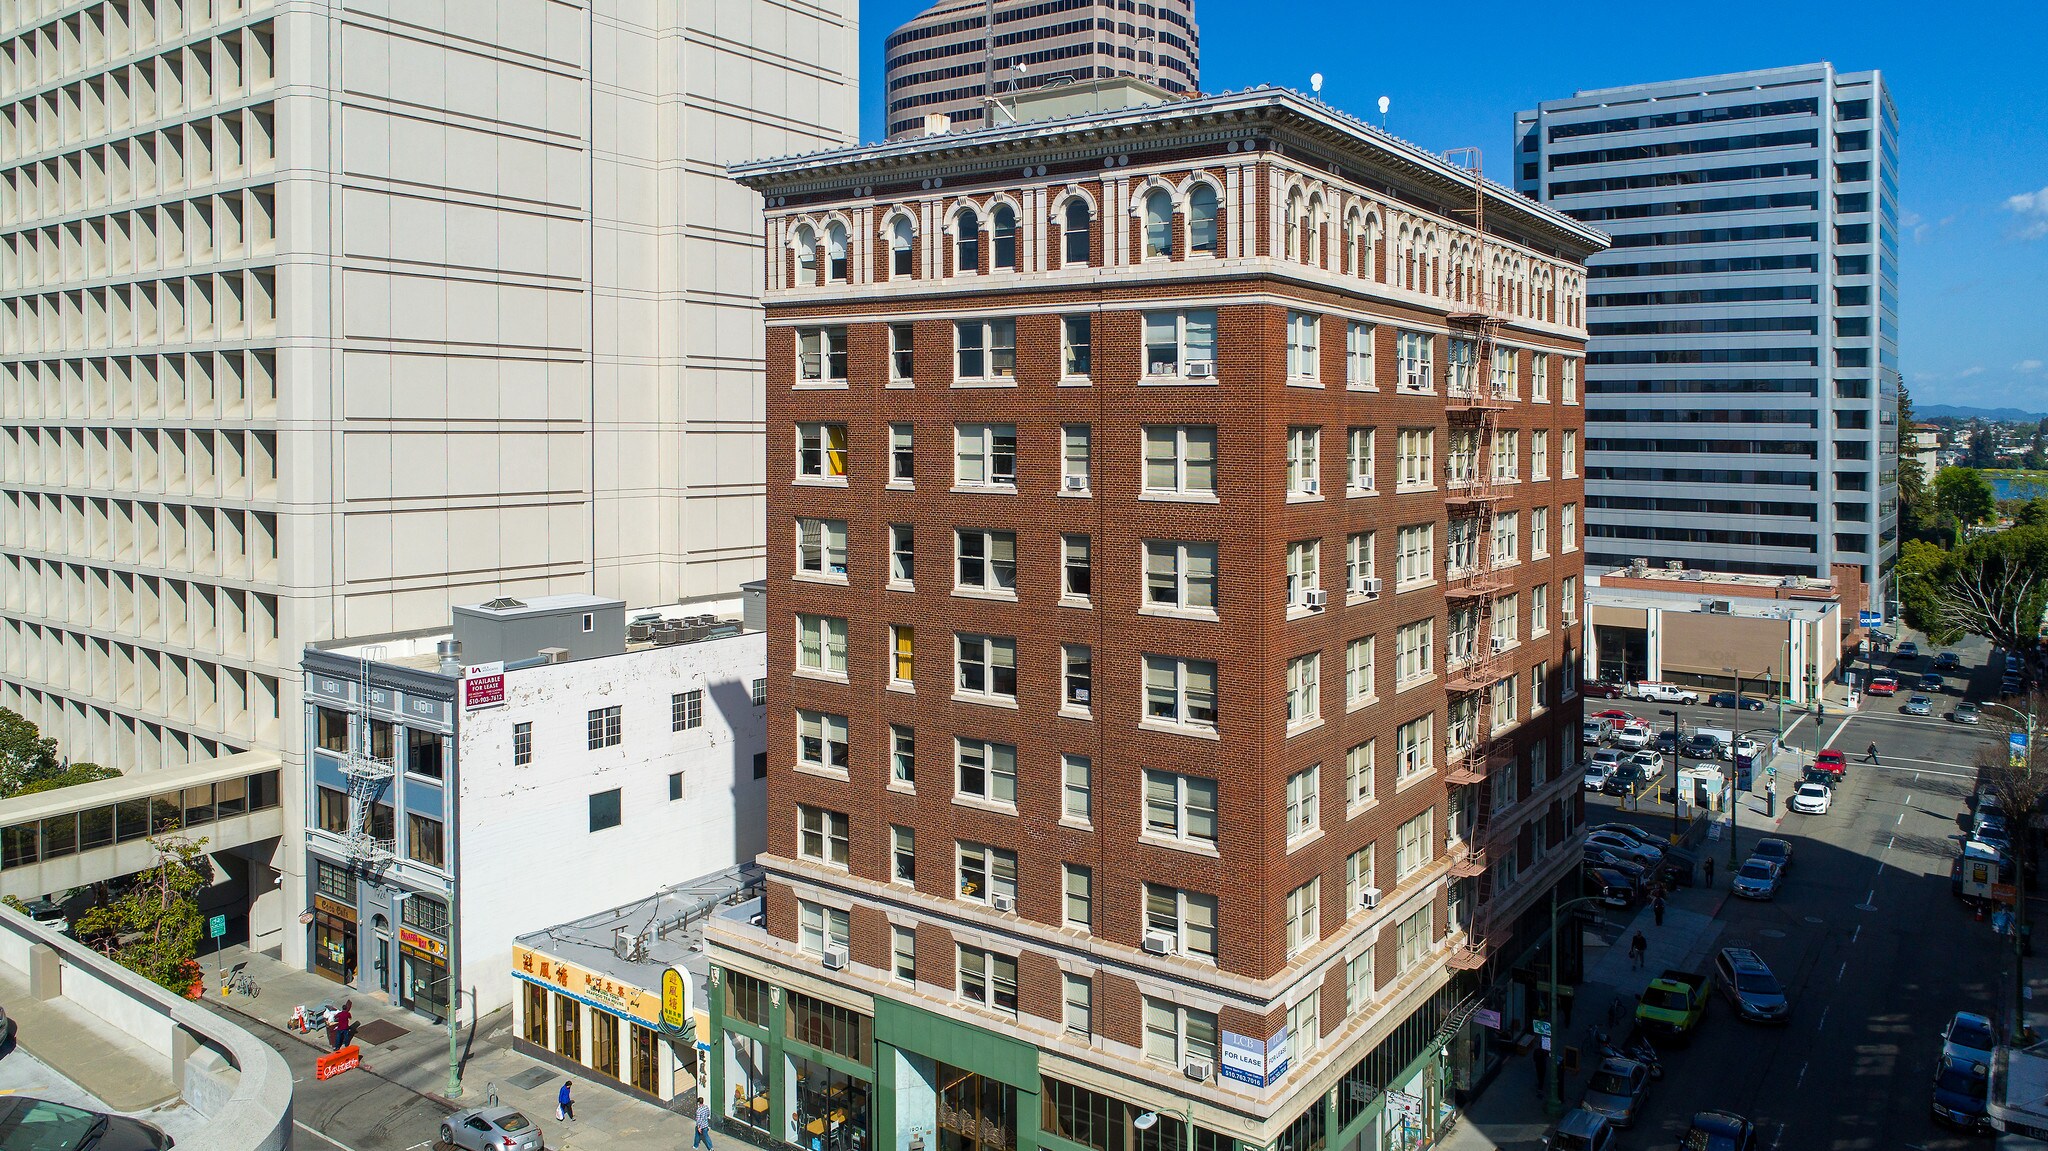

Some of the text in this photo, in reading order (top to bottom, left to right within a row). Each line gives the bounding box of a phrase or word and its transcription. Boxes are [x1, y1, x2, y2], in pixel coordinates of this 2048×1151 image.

[470, 676, 500, 686] AVAILABLE
[1233, 1034, 1254, 1048] LCB
[1224, 1050, 1262, 1067] FOR LEASE
[1268, 1046, 1287, 1065] FOR LEASE
